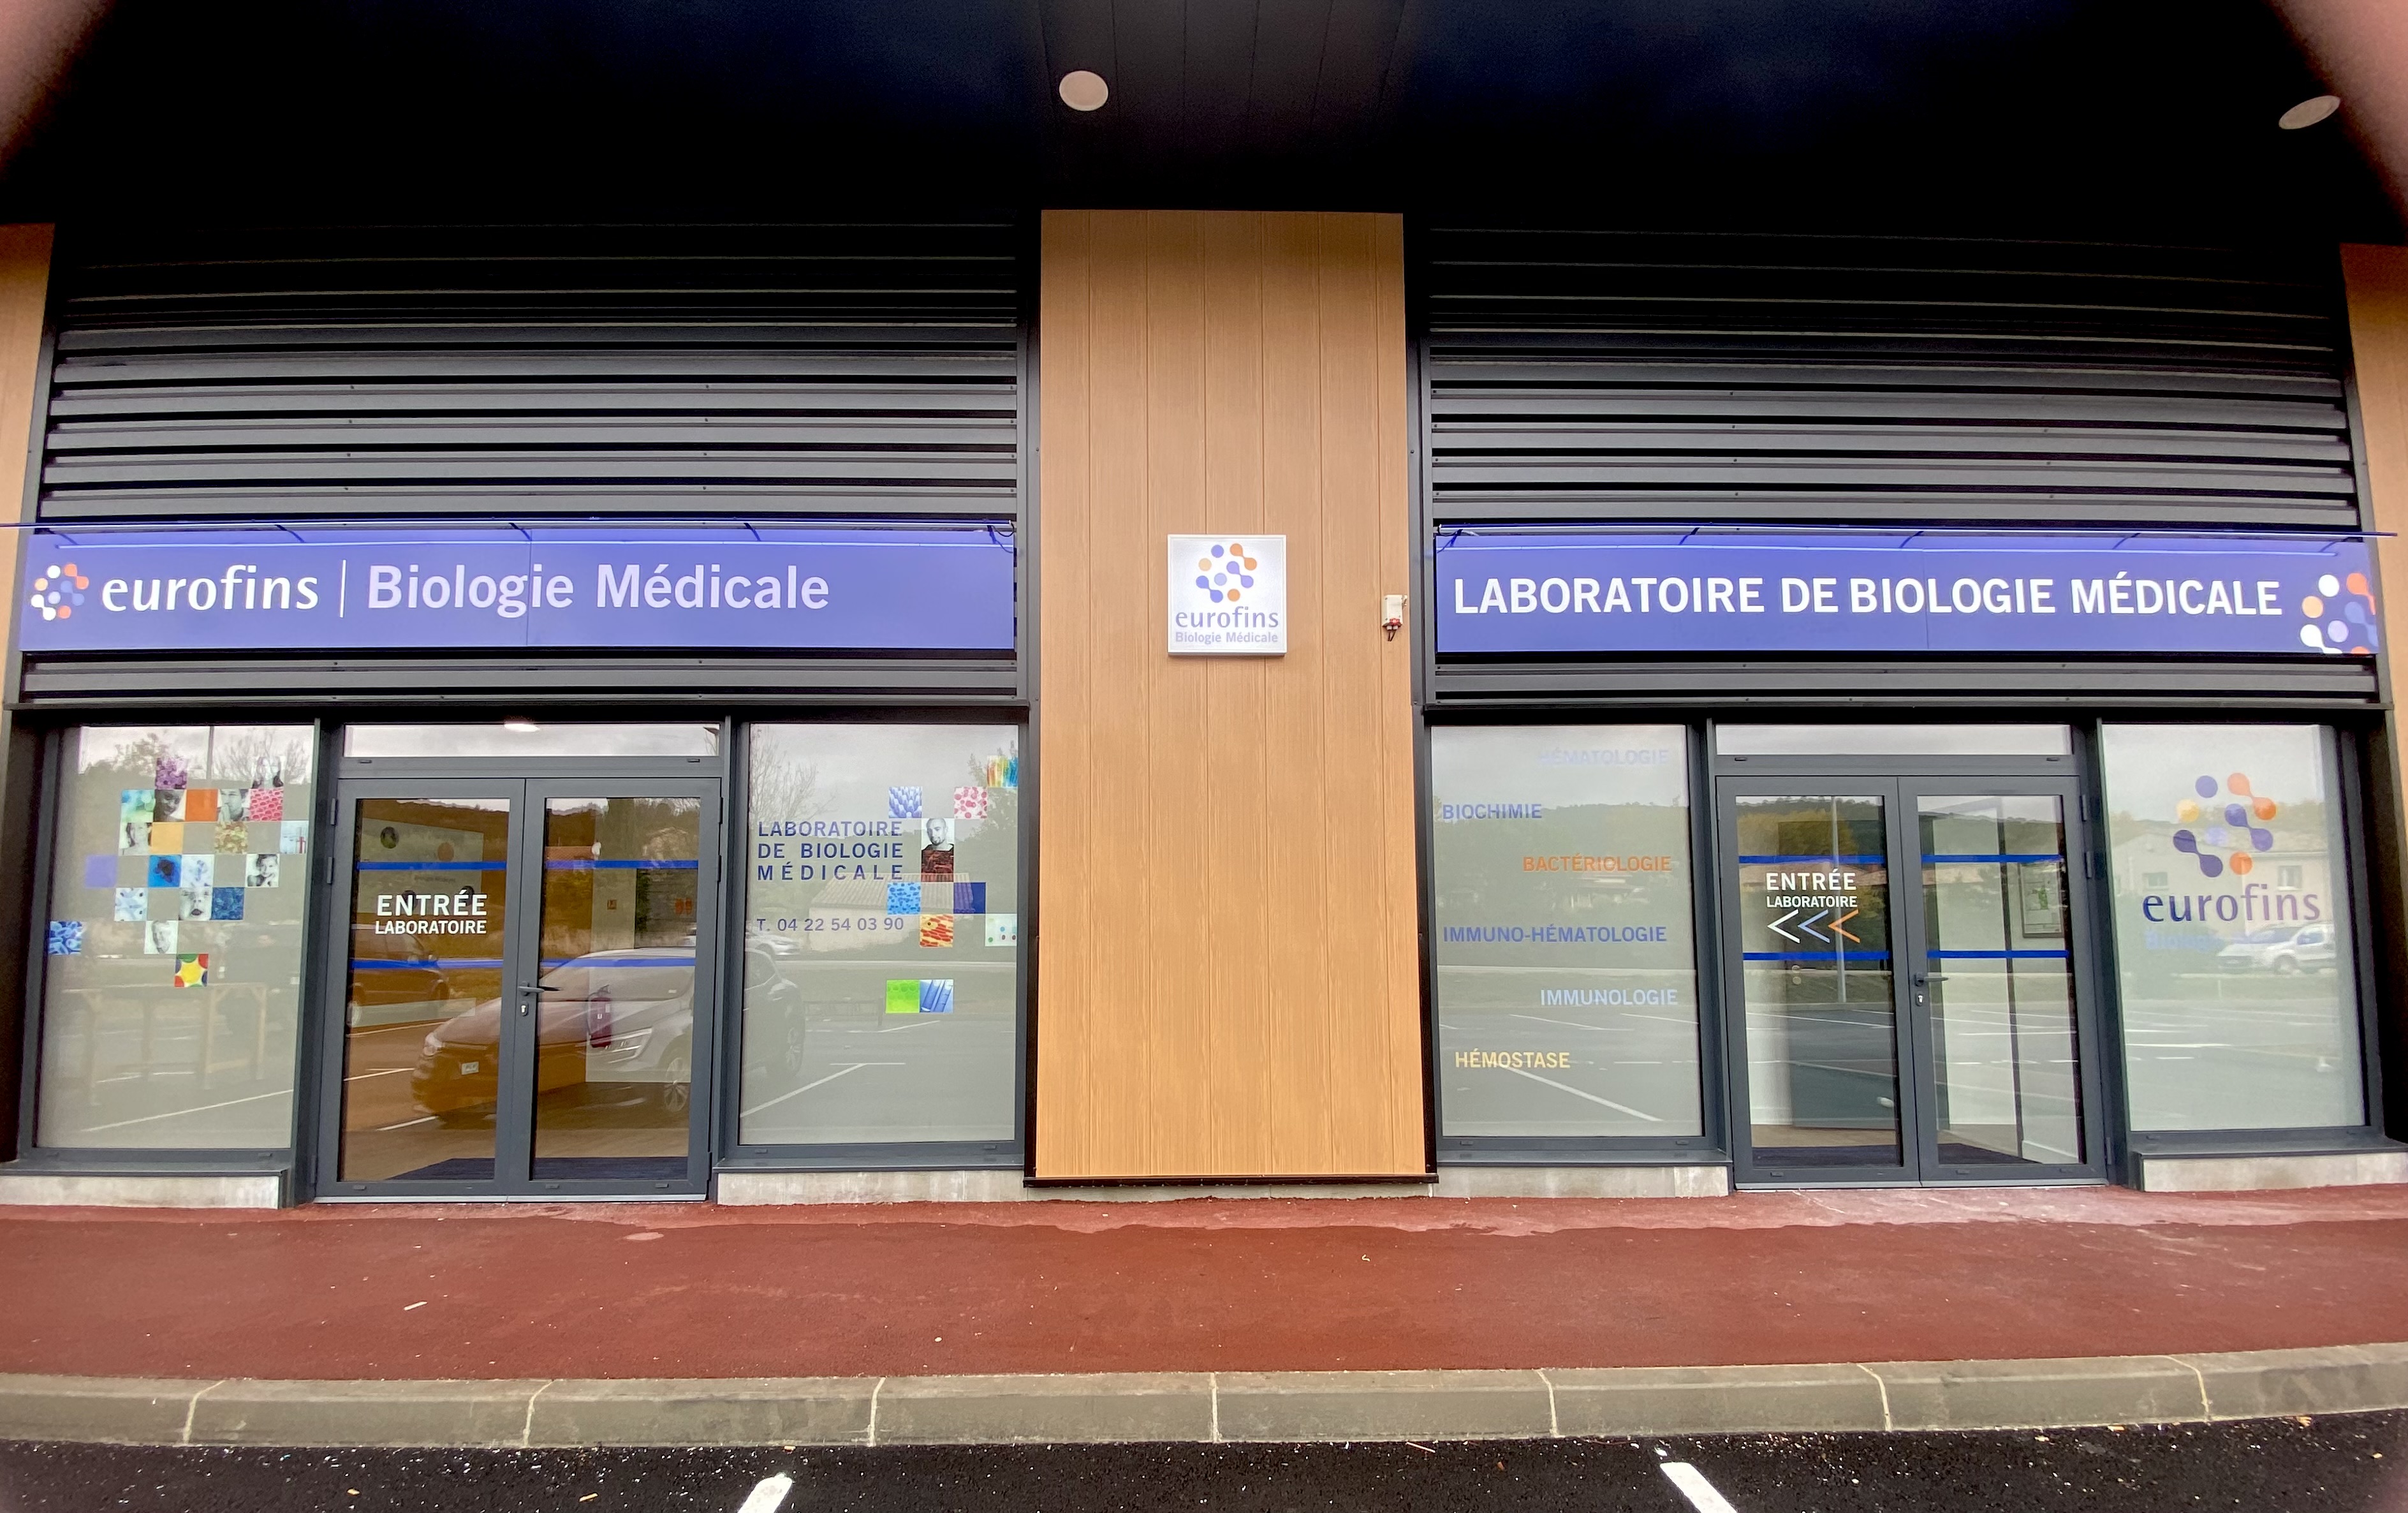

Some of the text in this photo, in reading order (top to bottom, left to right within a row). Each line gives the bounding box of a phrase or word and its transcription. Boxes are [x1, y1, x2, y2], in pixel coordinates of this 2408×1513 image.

[102, 565, 319, 612] eurofins
[368, 563, 829, 618] Biologie Médicale
[1454, 571, 2283, 616] LABORATOIRE DE BIOLOGIE MÉDICALE
[1175, 606, 1279, 628] eurofins
[1175, 631, 1278, 645] Biologie Médicale
[1443, 804, 1542, 820] BIOCHIMIE
[758, 821, 903, 837] LABORATOIRE
[758, 843, 903, 859] DE BIOLOGIE
[758, 862, 903, 881] MÉDICALE
[1523, 853, 1672, 872] BACTÉRIOLOGIE
[1766, 869, 1857, 890] ENTRÉE
[376, 889, 487, 917] ENTRÉE
[1766, 896, 1857, 908] LABORATOIRE
[2143, 883, 2321, 922] eurofins
[375, 920, 487, 934] LABORATOIRE
[757, 917, 904, 931] T. 04 22 54 03 90
[1443, 924, 1667, 943] IMMUNO-HÉMATOLOGIE
[1540, 989, 1678, 1005] IMMUNOLOGIE
[1455, 1048, 1571, 1068] HÉMOSTASE
